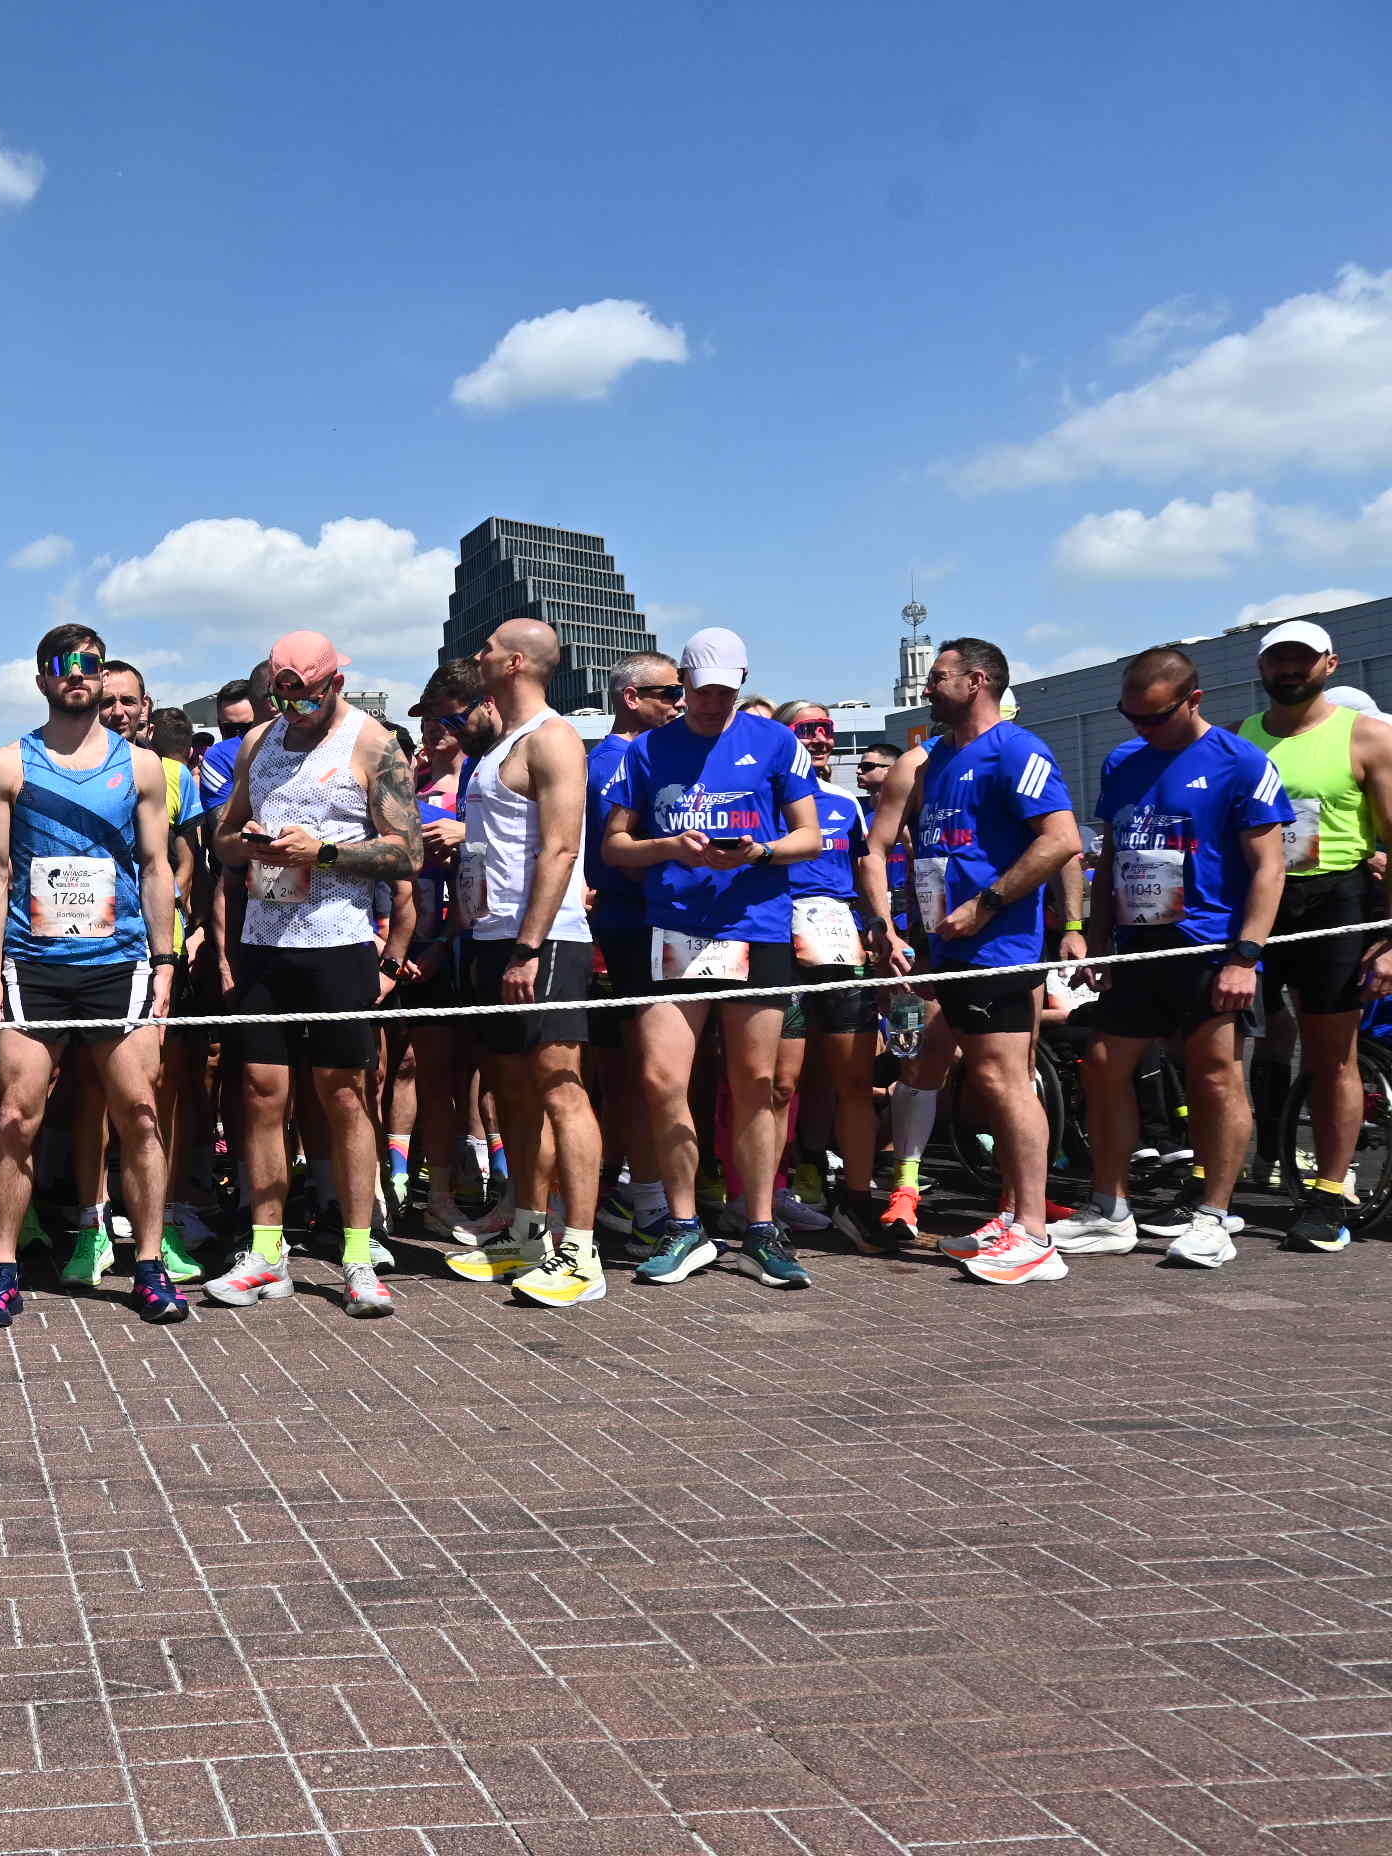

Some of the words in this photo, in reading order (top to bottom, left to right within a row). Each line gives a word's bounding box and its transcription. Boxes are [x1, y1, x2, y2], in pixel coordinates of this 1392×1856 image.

[669, 811, 728, 830] WORLD
[730, 811, 760, 829] RUN
[53, 892, 95, 905] 17284
